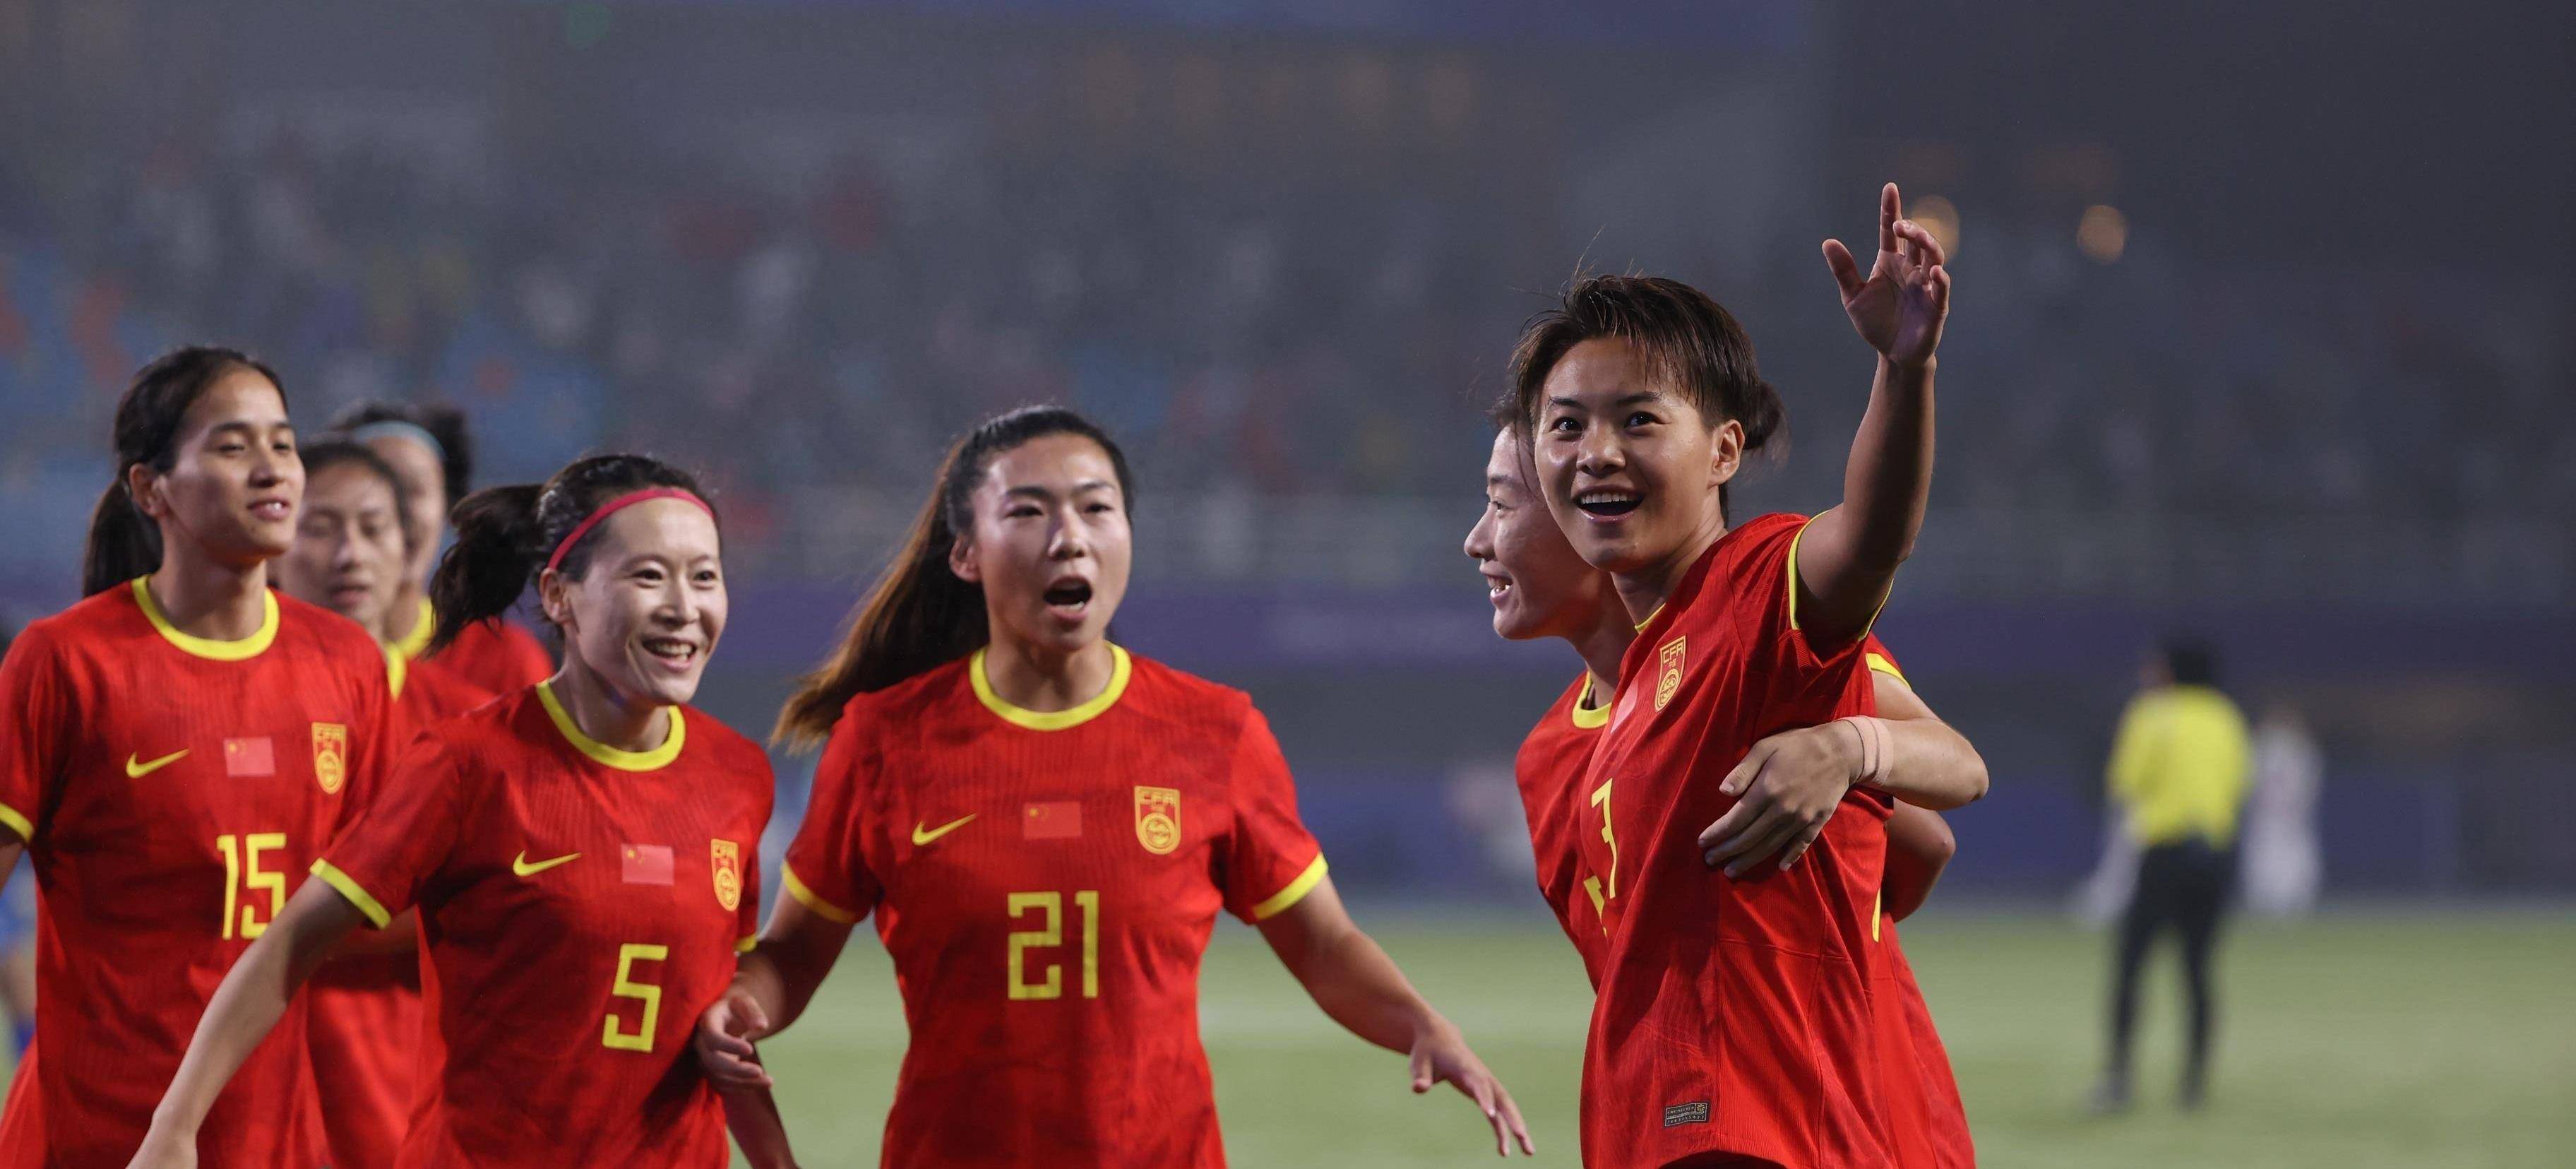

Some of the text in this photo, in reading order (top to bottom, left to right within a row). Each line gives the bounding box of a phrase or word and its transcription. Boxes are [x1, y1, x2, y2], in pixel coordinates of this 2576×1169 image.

[1663, 642, 1683, 664] CFA
[216, 833, 286, 939] 15
[603, 944, 668, 1052] 5
[1008, 891, 1099, 999] 21
